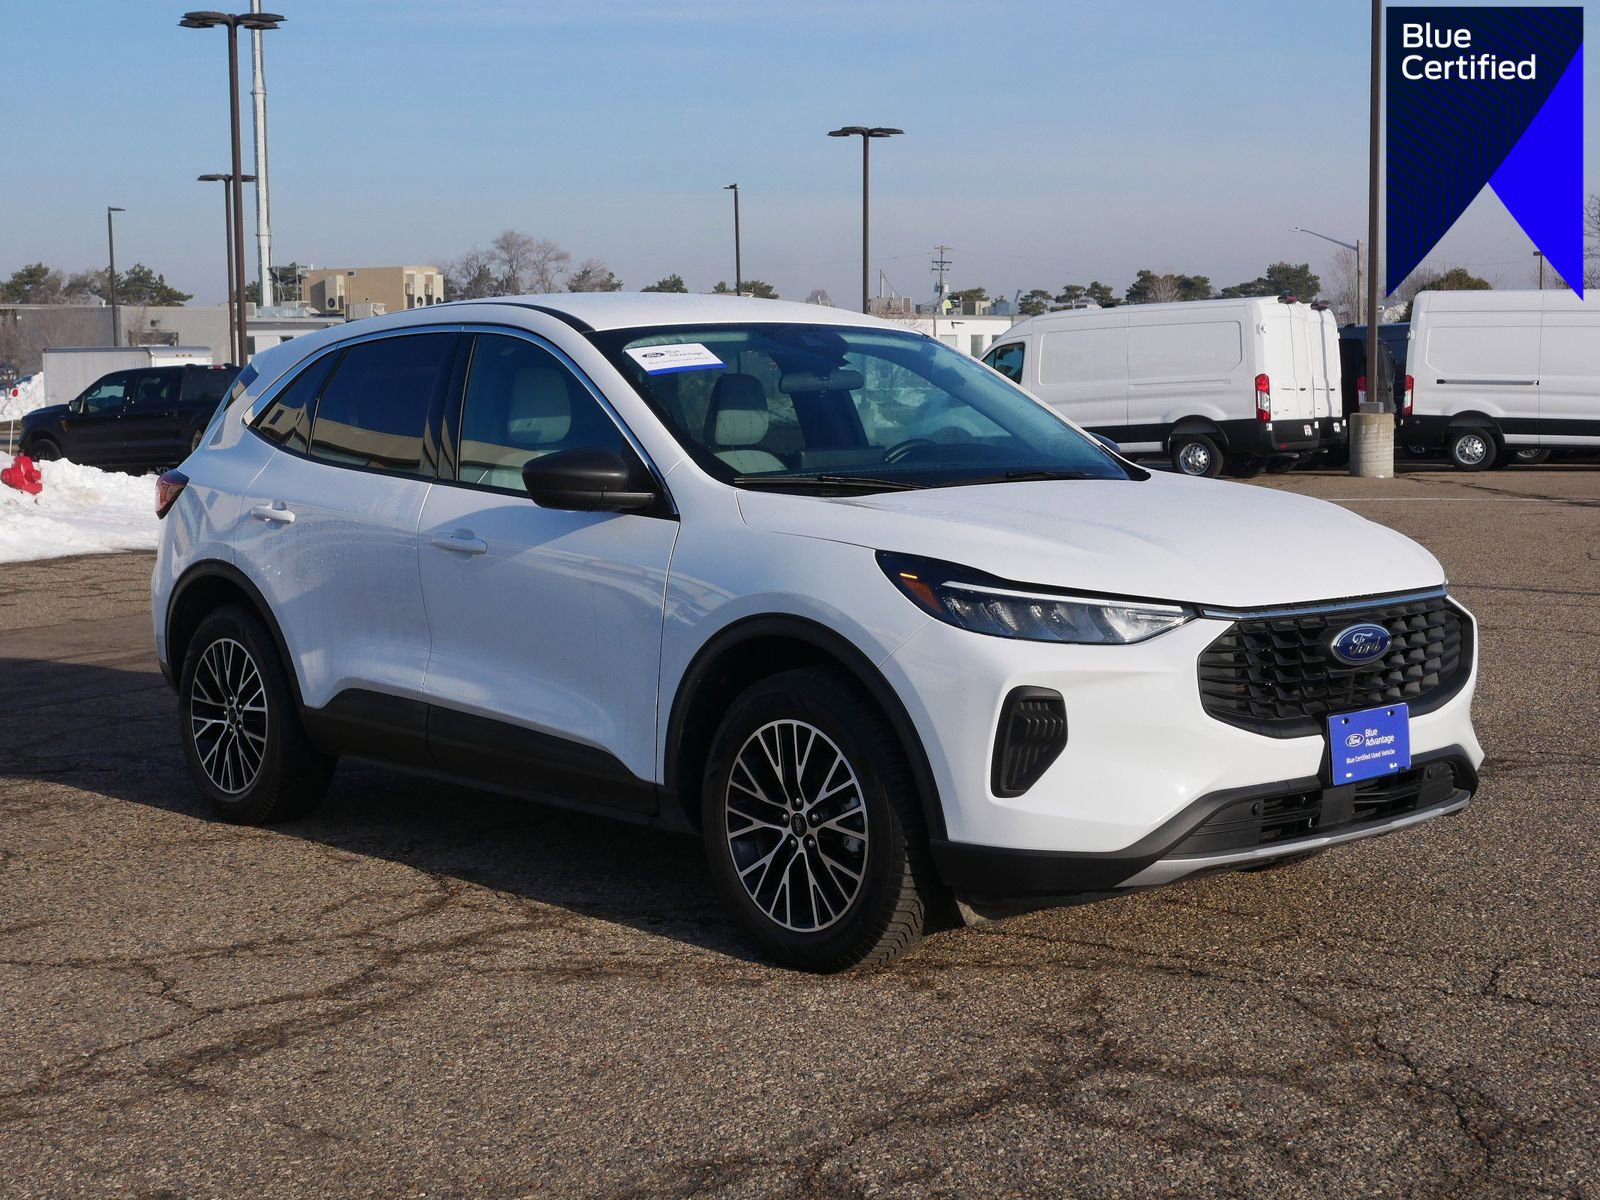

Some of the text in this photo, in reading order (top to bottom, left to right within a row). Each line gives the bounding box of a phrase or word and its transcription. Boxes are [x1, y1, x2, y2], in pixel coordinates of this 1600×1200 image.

[1349, 632, 1381, 656] Ford
[1365, 728, 1378, 737] Blue
[1365, 735, 1395, 747] Advantage
